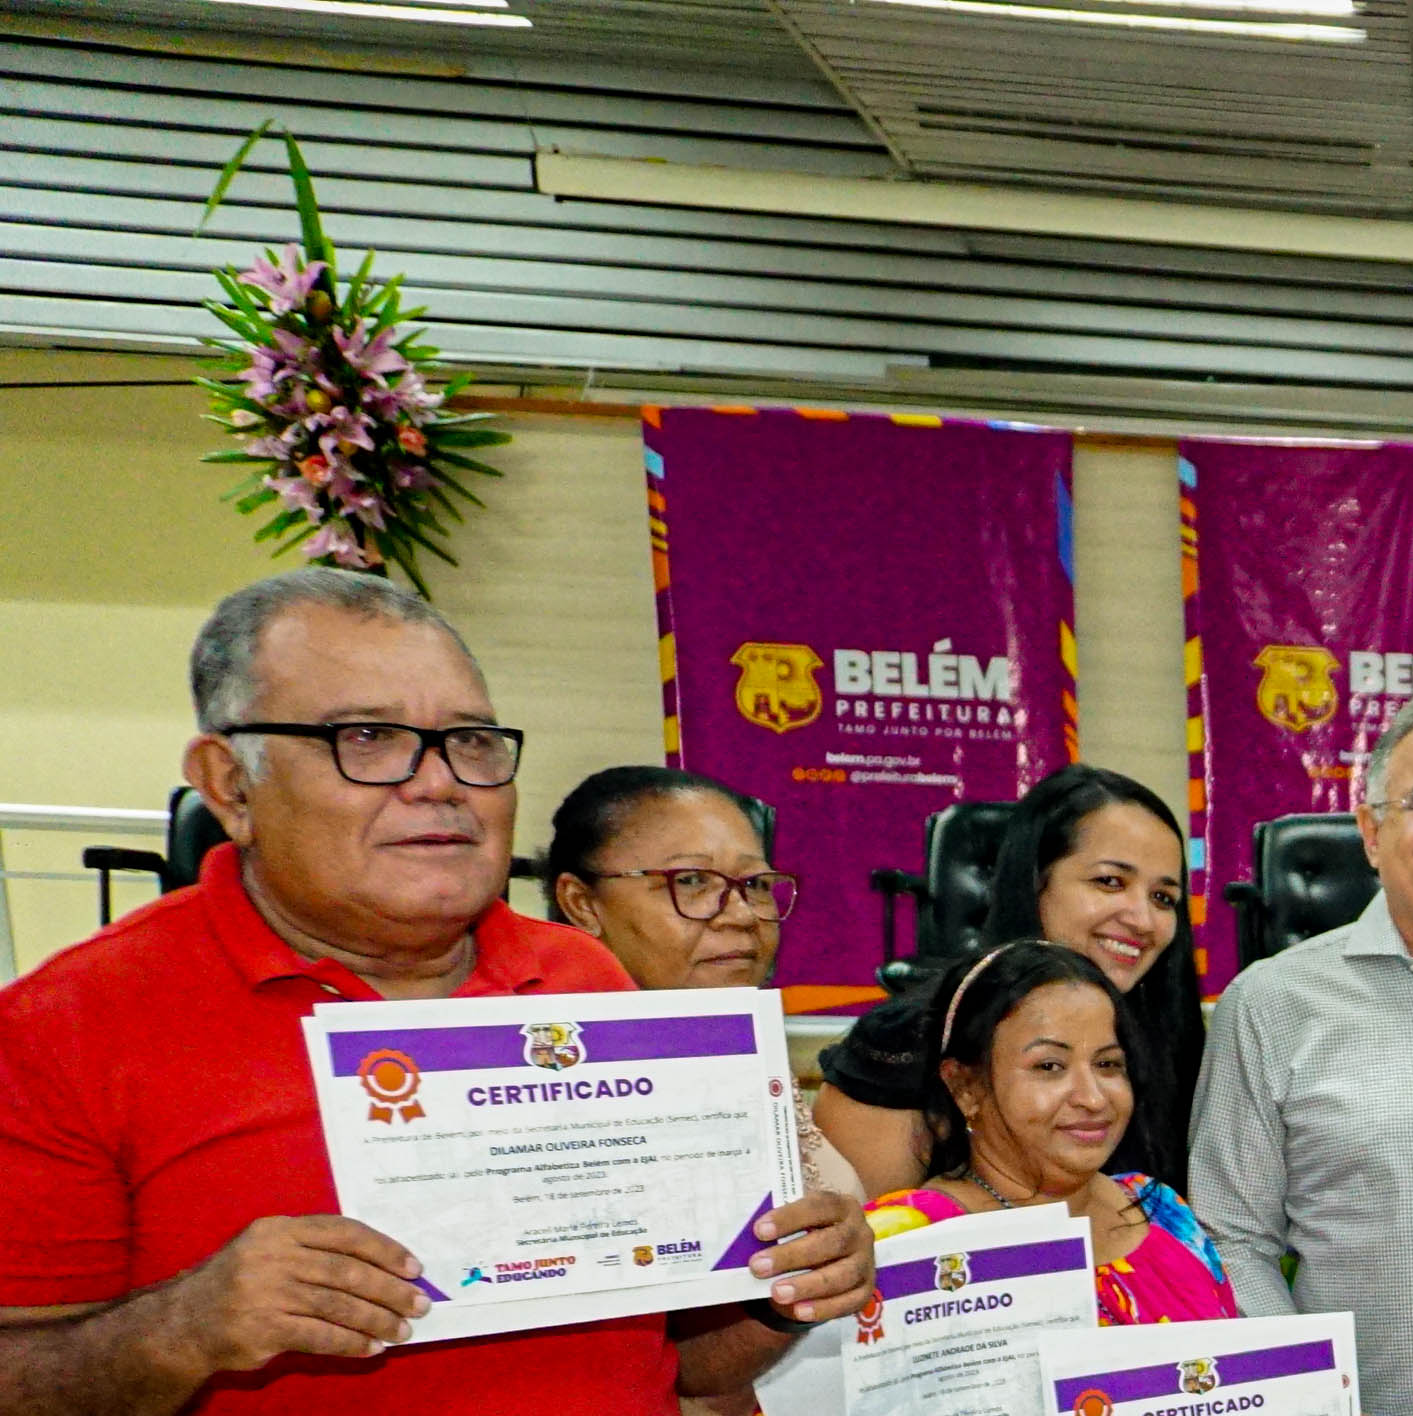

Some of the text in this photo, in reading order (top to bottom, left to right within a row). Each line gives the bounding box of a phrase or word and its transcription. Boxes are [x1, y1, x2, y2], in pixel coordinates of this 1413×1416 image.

[833, 637, 1012, 701] BELÉM
[835, 700, 1013, 725] PREFEITURA
[838, 723, 876, 735] TAMO
[883, 724, 929, 736] JUNTO
[467, 1077, 654, 1107] CERTIFICADO
[489, 1136, 647, 1157] DILAMAR OLIVEIRA FONSECA
[656, 1238, 701, 1256] BELÉM
[495, 1256, 577, 1273] TAMO JUNTO
[496, 1267, 567, 1284] EDUCANDO
[904, 1292, 1013, 1326] CERTIFICADO
